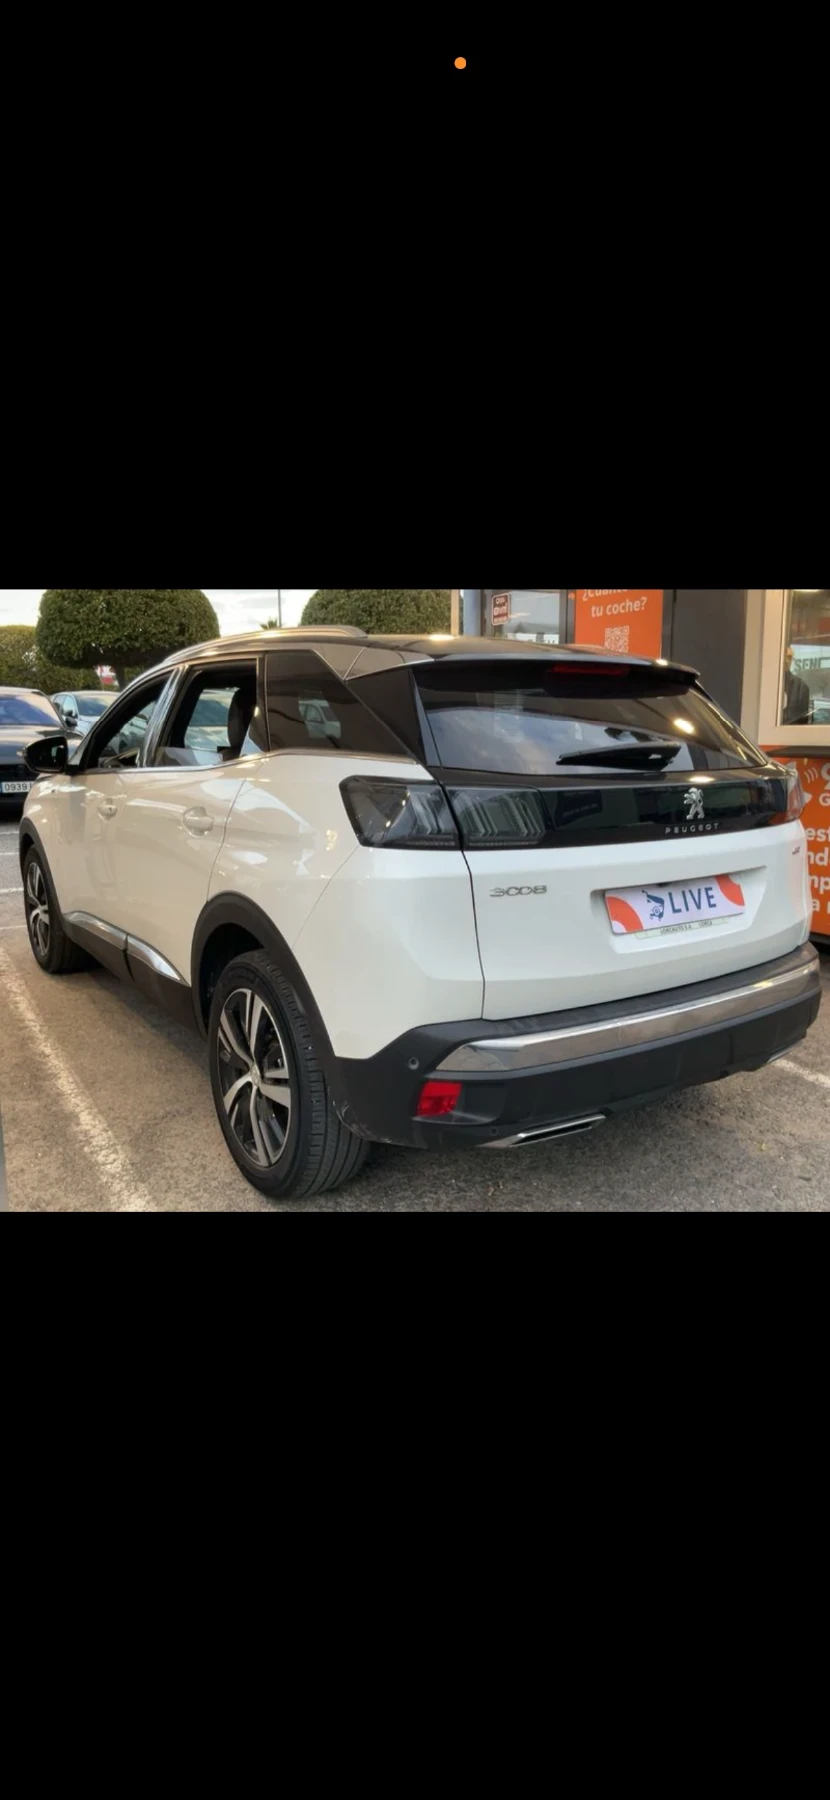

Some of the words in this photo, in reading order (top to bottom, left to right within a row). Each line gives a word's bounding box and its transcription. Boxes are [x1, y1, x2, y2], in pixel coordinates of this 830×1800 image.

[591, 605, 603, 618] tu
[606, 596, 648, 616] coche?
[665, 822, 719, 835] PEUGEOT
[489, 884, 548, 898] 3008
[668, 886, 717, 914] LIVE
